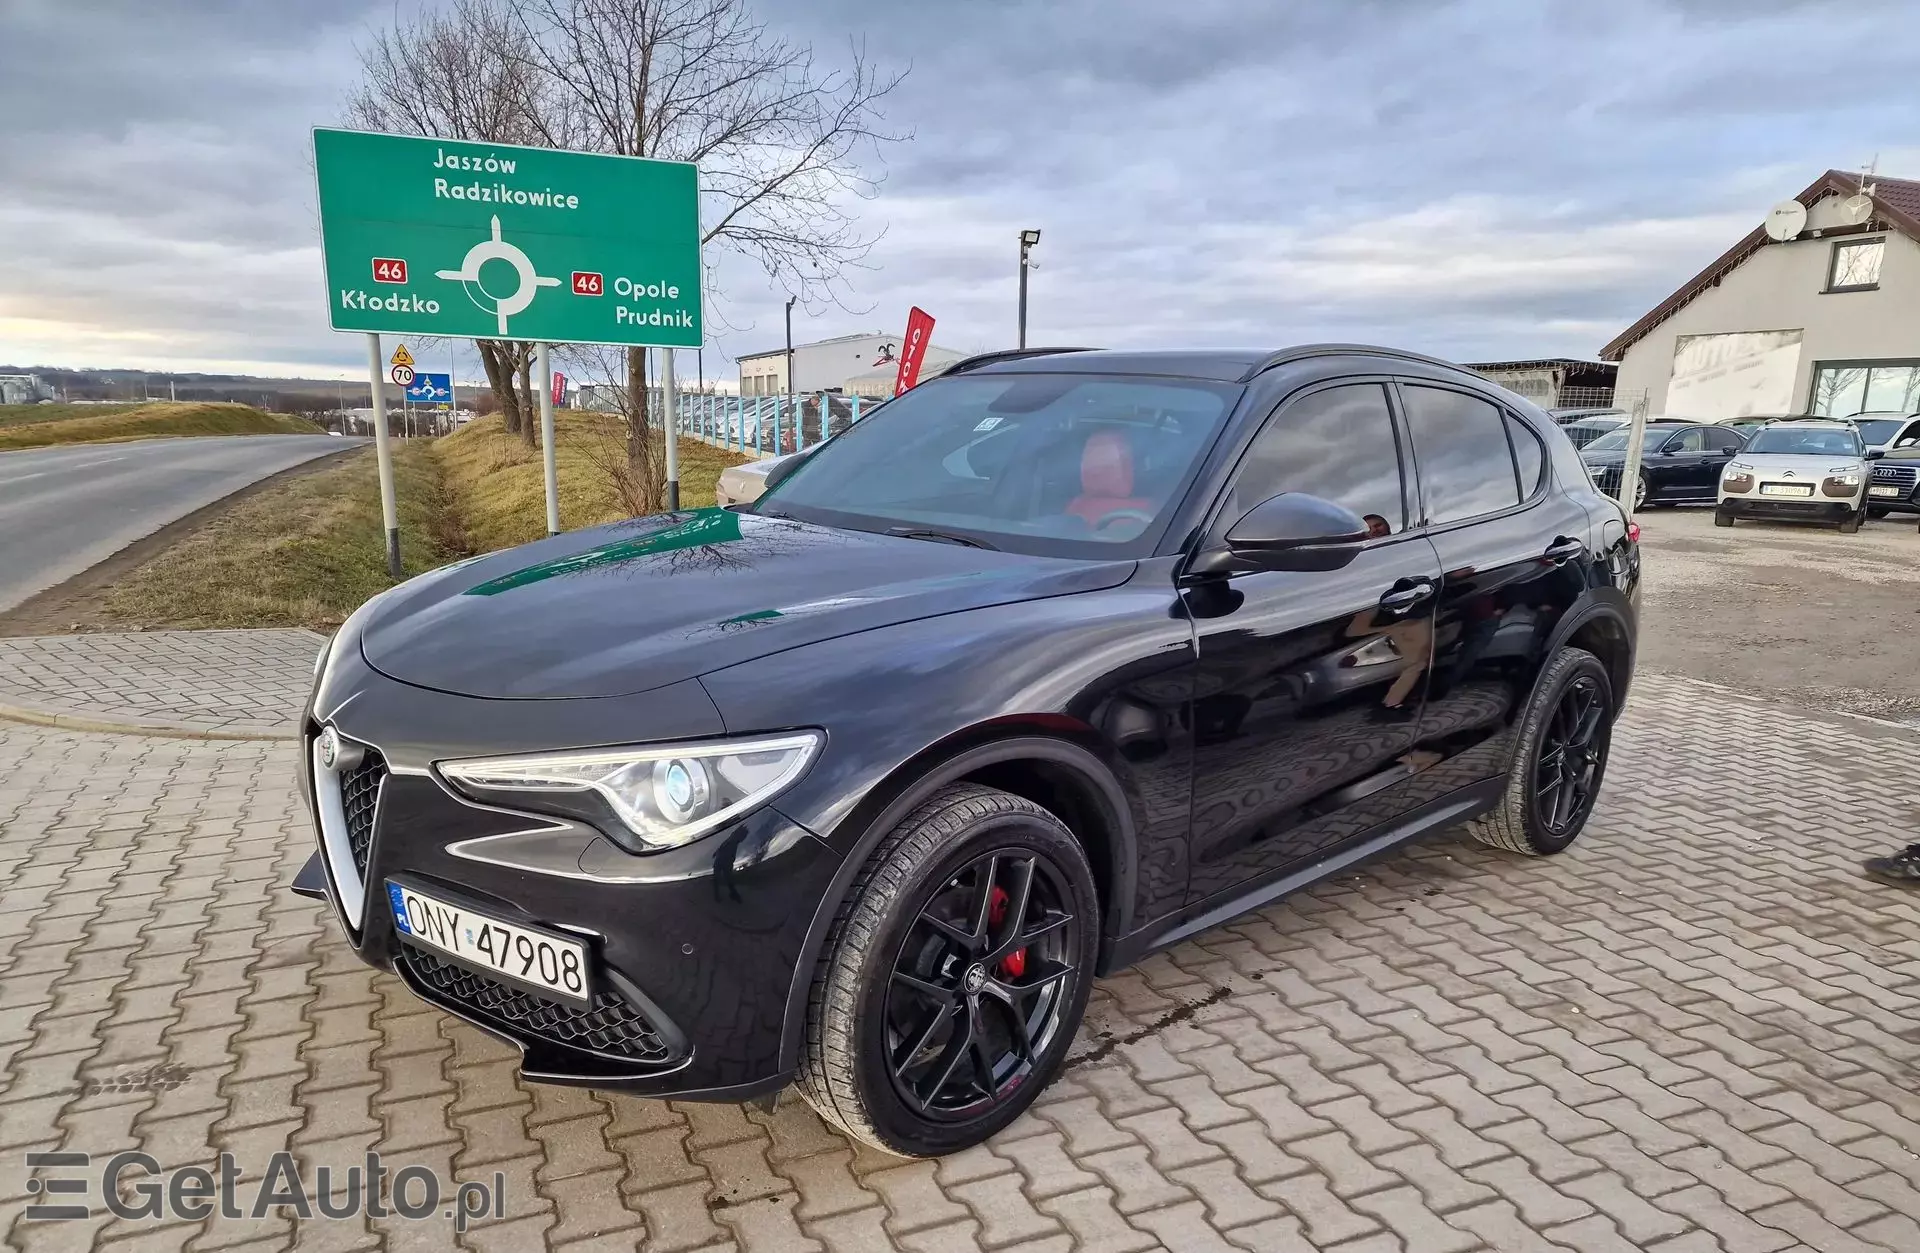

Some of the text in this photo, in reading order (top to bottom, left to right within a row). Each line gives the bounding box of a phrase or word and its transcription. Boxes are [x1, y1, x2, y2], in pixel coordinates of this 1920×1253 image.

[433, 148, 516, 174] Jaszów
[434, 178, 579, 210] Radzikowice
[378, 262, 402, 280] 46
[576, 275, 599, 292] 46
[613, 277, 679, 301] Opole
[341, 289, 440, 315] Kłodzko
[616, 306, 693, 328] Prudnik
[396, 370, 412, 381] 70
[407, 895, 582, 993] ONY 47908
